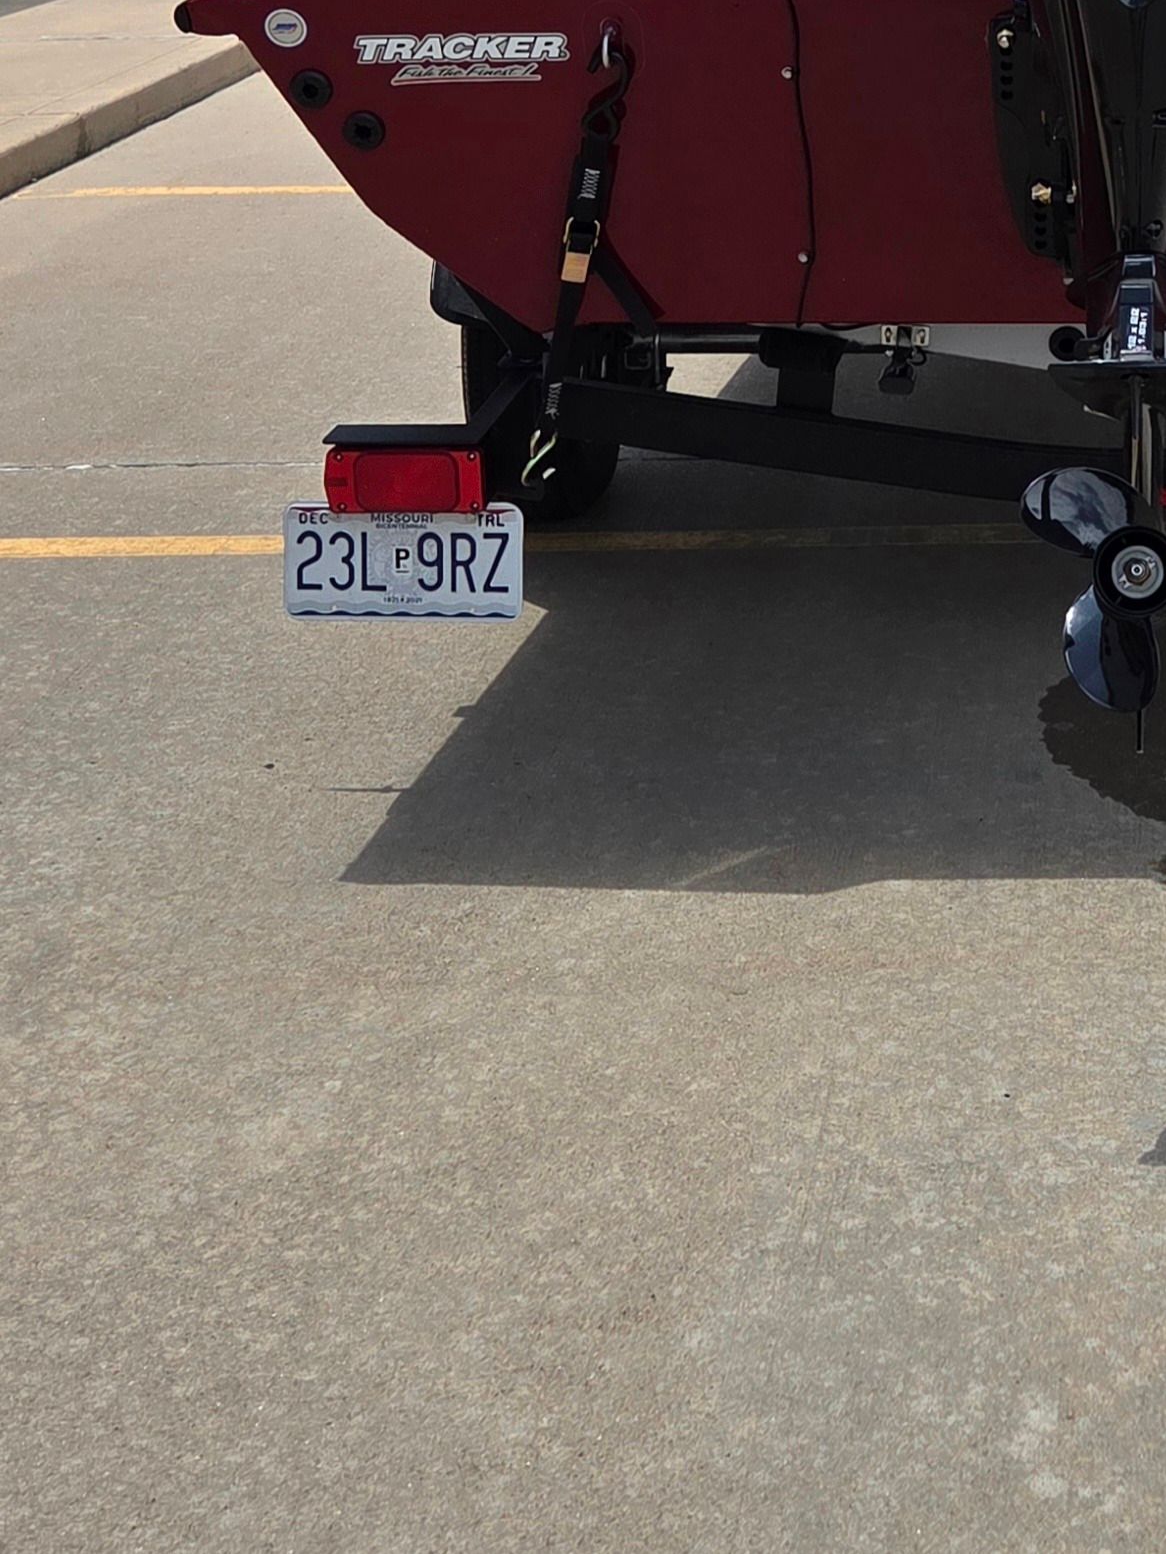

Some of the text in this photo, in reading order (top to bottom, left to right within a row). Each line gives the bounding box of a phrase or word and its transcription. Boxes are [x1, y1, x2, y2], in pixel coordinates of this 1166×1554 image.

[357, 35, 562, 60] TRACKER
[298, 513, 329, 525] DEC
[370, 513, 434, 523] MISSOURI
[477, 514, 506, 527] TRL
[296, 530, 510, 593] 23L 9RZ
[395, 548, 410, 570] P
